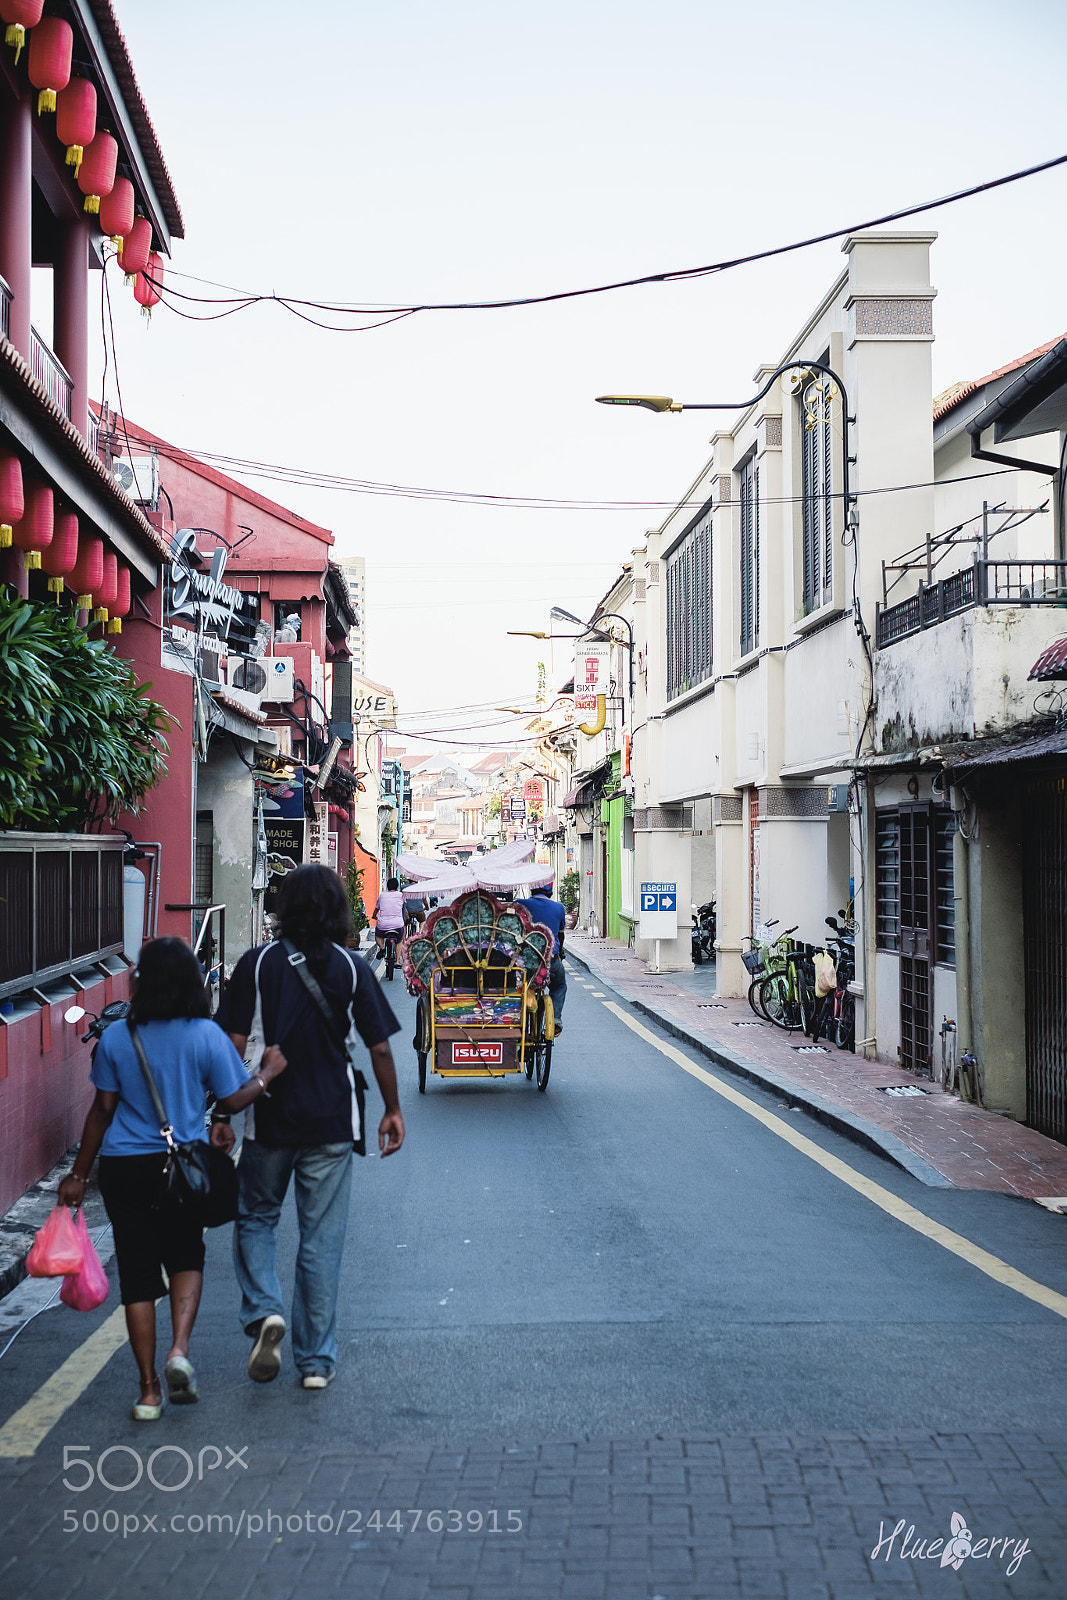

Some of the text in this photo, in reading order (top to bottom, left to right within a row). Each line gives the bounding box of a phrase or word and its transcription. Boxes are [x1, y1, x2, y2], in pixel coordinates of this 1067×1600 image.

[266, 829, 293, 838] MADE
[273, 840, 299, 848] SHOE
[644, 895, 656, 910] P
[455, 1048, 500, 1057] ISUZU
